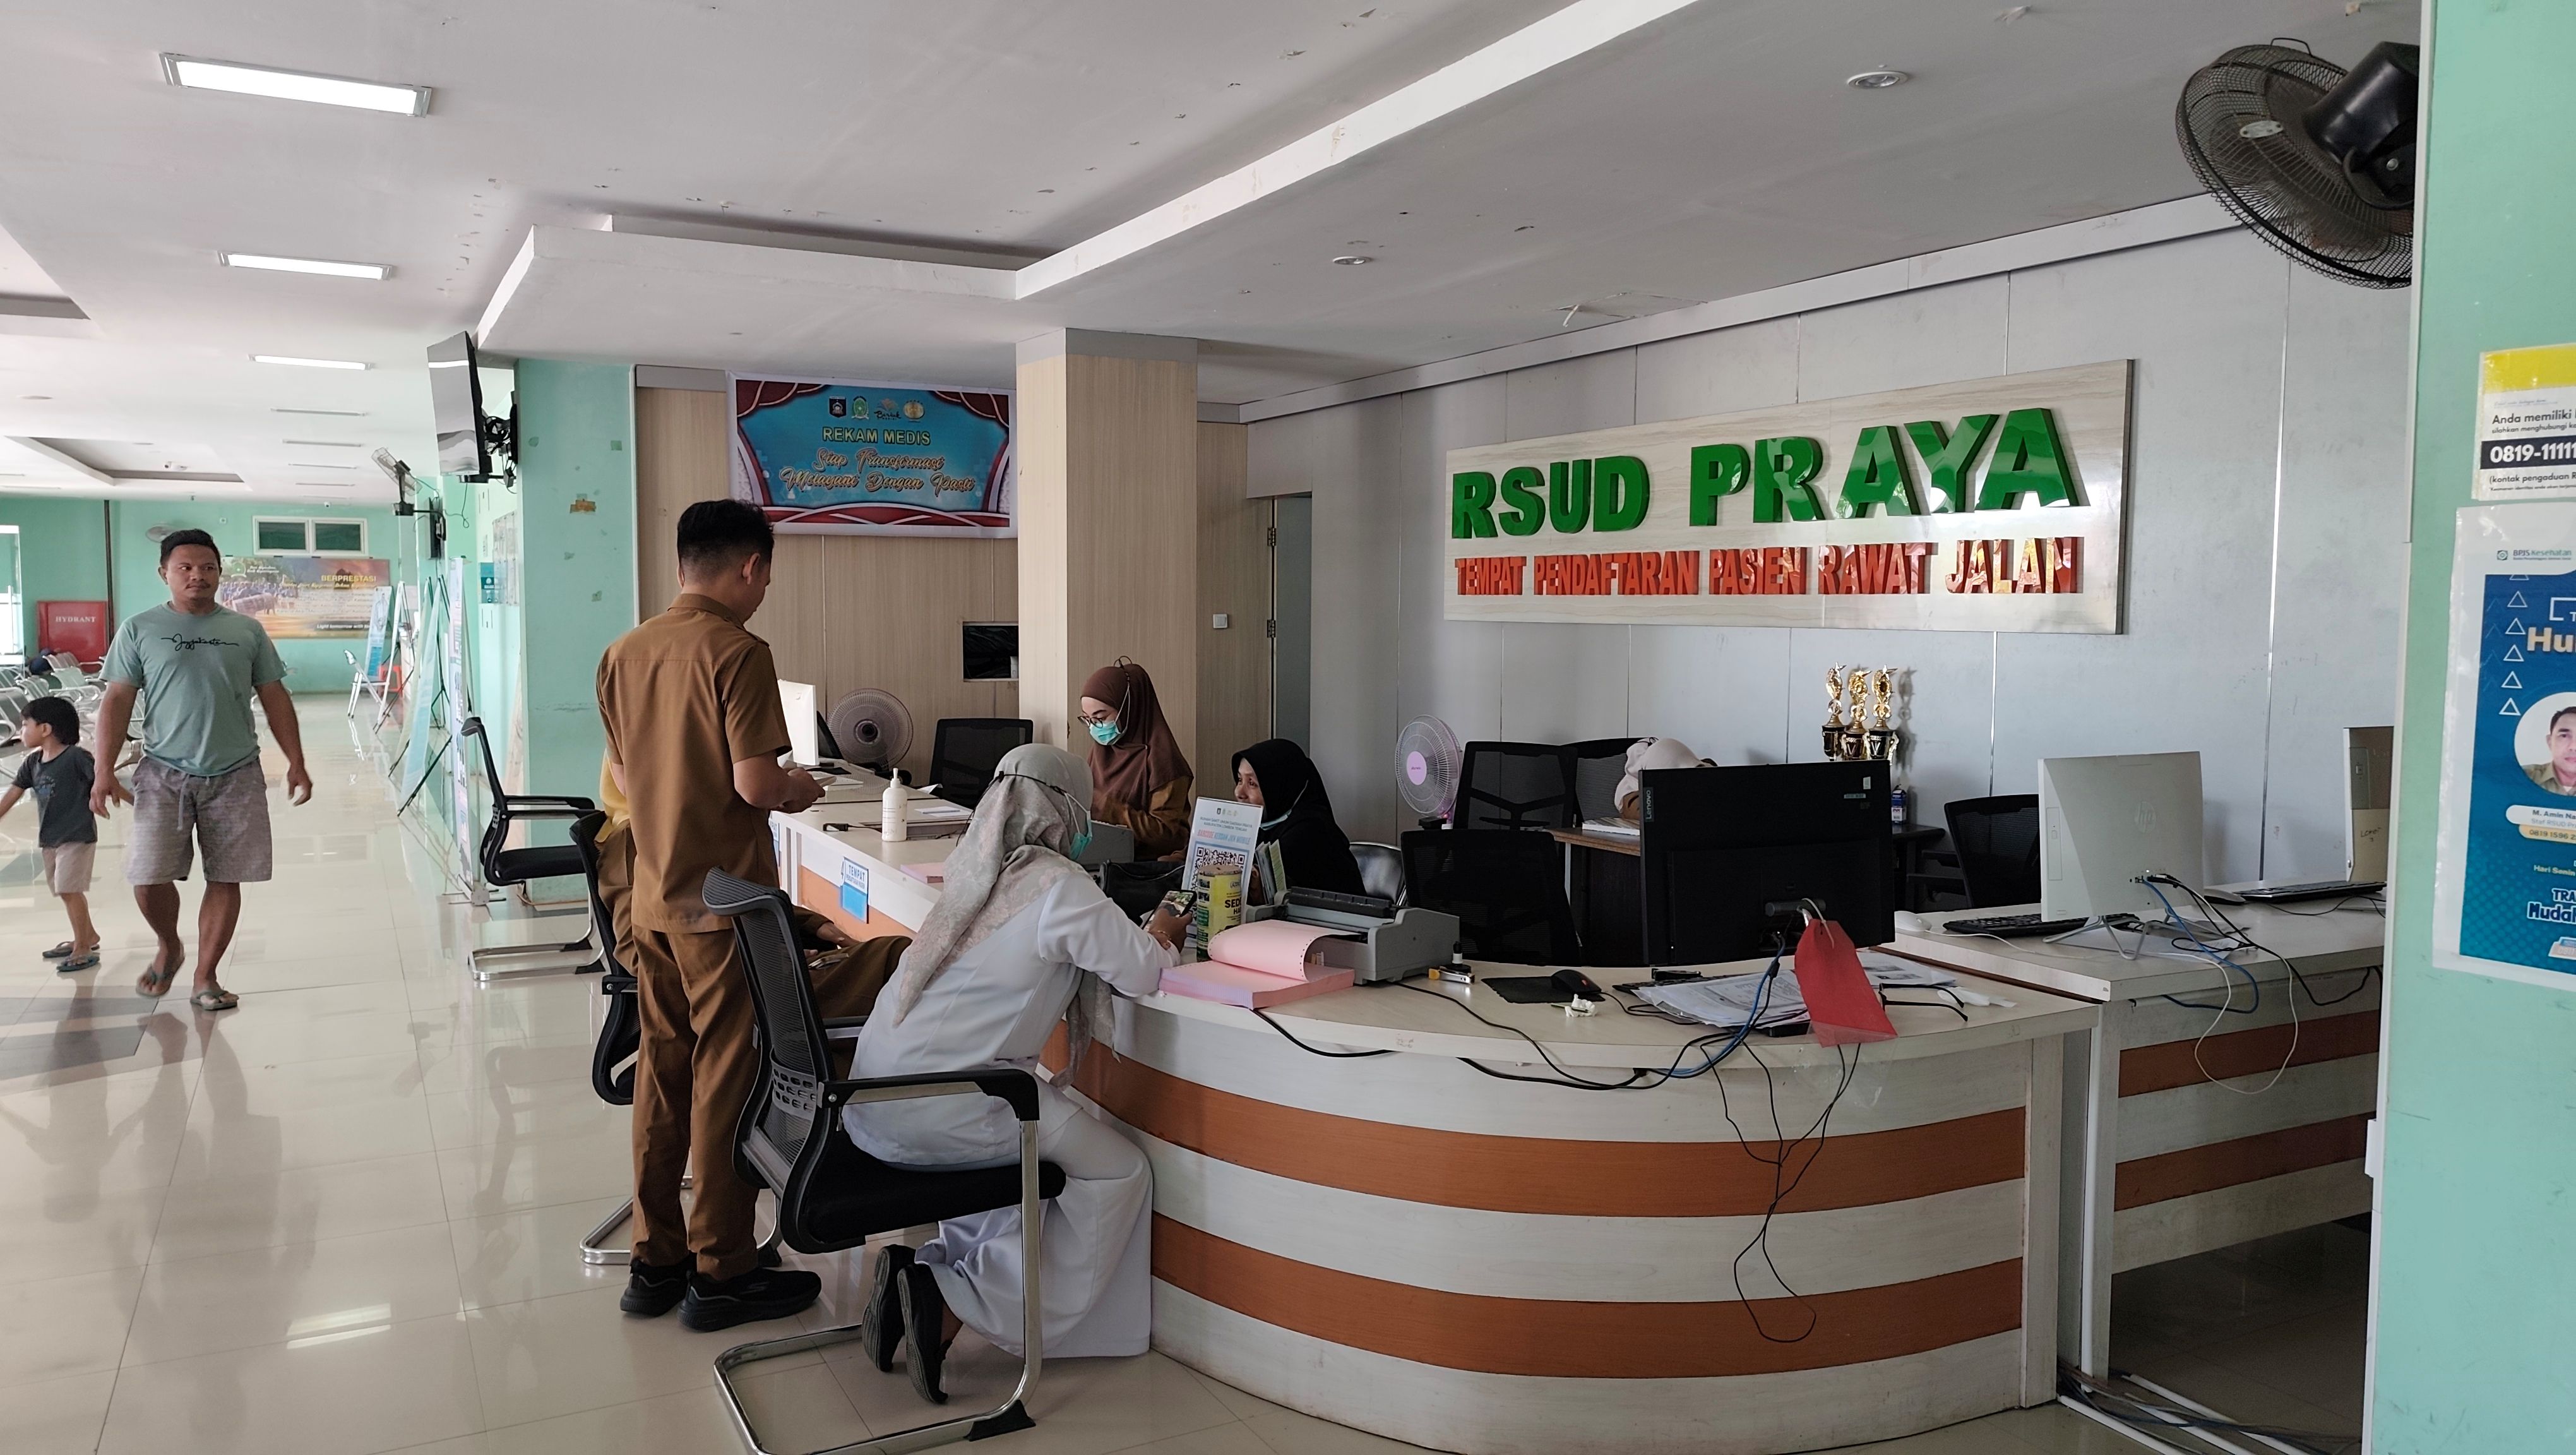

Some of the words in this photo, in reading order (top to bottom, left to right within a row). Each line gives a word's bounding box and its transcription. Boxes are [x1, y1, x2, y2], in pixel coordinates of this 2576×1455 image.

[2492, 413, 2520, 424] Anda
[2524, 409, 2572, 422] memiliki
[823, 427, 878, 443] REKAM
[884, 429, 931, 446] MEDIS
[2520, 422, 2567, 433] menghubungi
[814, 448, 849, 471] Siap
[856, 447, 945, 473] Transformasi
[779, 466, 860, 491] Melayani
[864, 471, 924, 492] Dengan
[931, 471, 976, 497] Pasti
[1452, 455, 1650, 539] RSUD
[1690, 407, 2080, 526] PRAYA
[2490, 474, 2520, 484] (kontak
[2522, 472, 2569, 484] pengaduan
[1455, 556, 1527, 595] TEMPAT
[1534, 551, 1700, 595] PENDAFTARAN
[1709, 546, 1807, 595] PASIEN
[1818, 542, 1938, 594] RAWAT
[1945, 537, 2077, 594] JALAN
[2135, 801, 2156, 834] hp
[2550, 831, 2568, 839] 1596
[849, 865, 865, 882] TEMPAT
[2534, 865, 2551, 873] Hari
[2552, 867, 2576, 877] Senin
